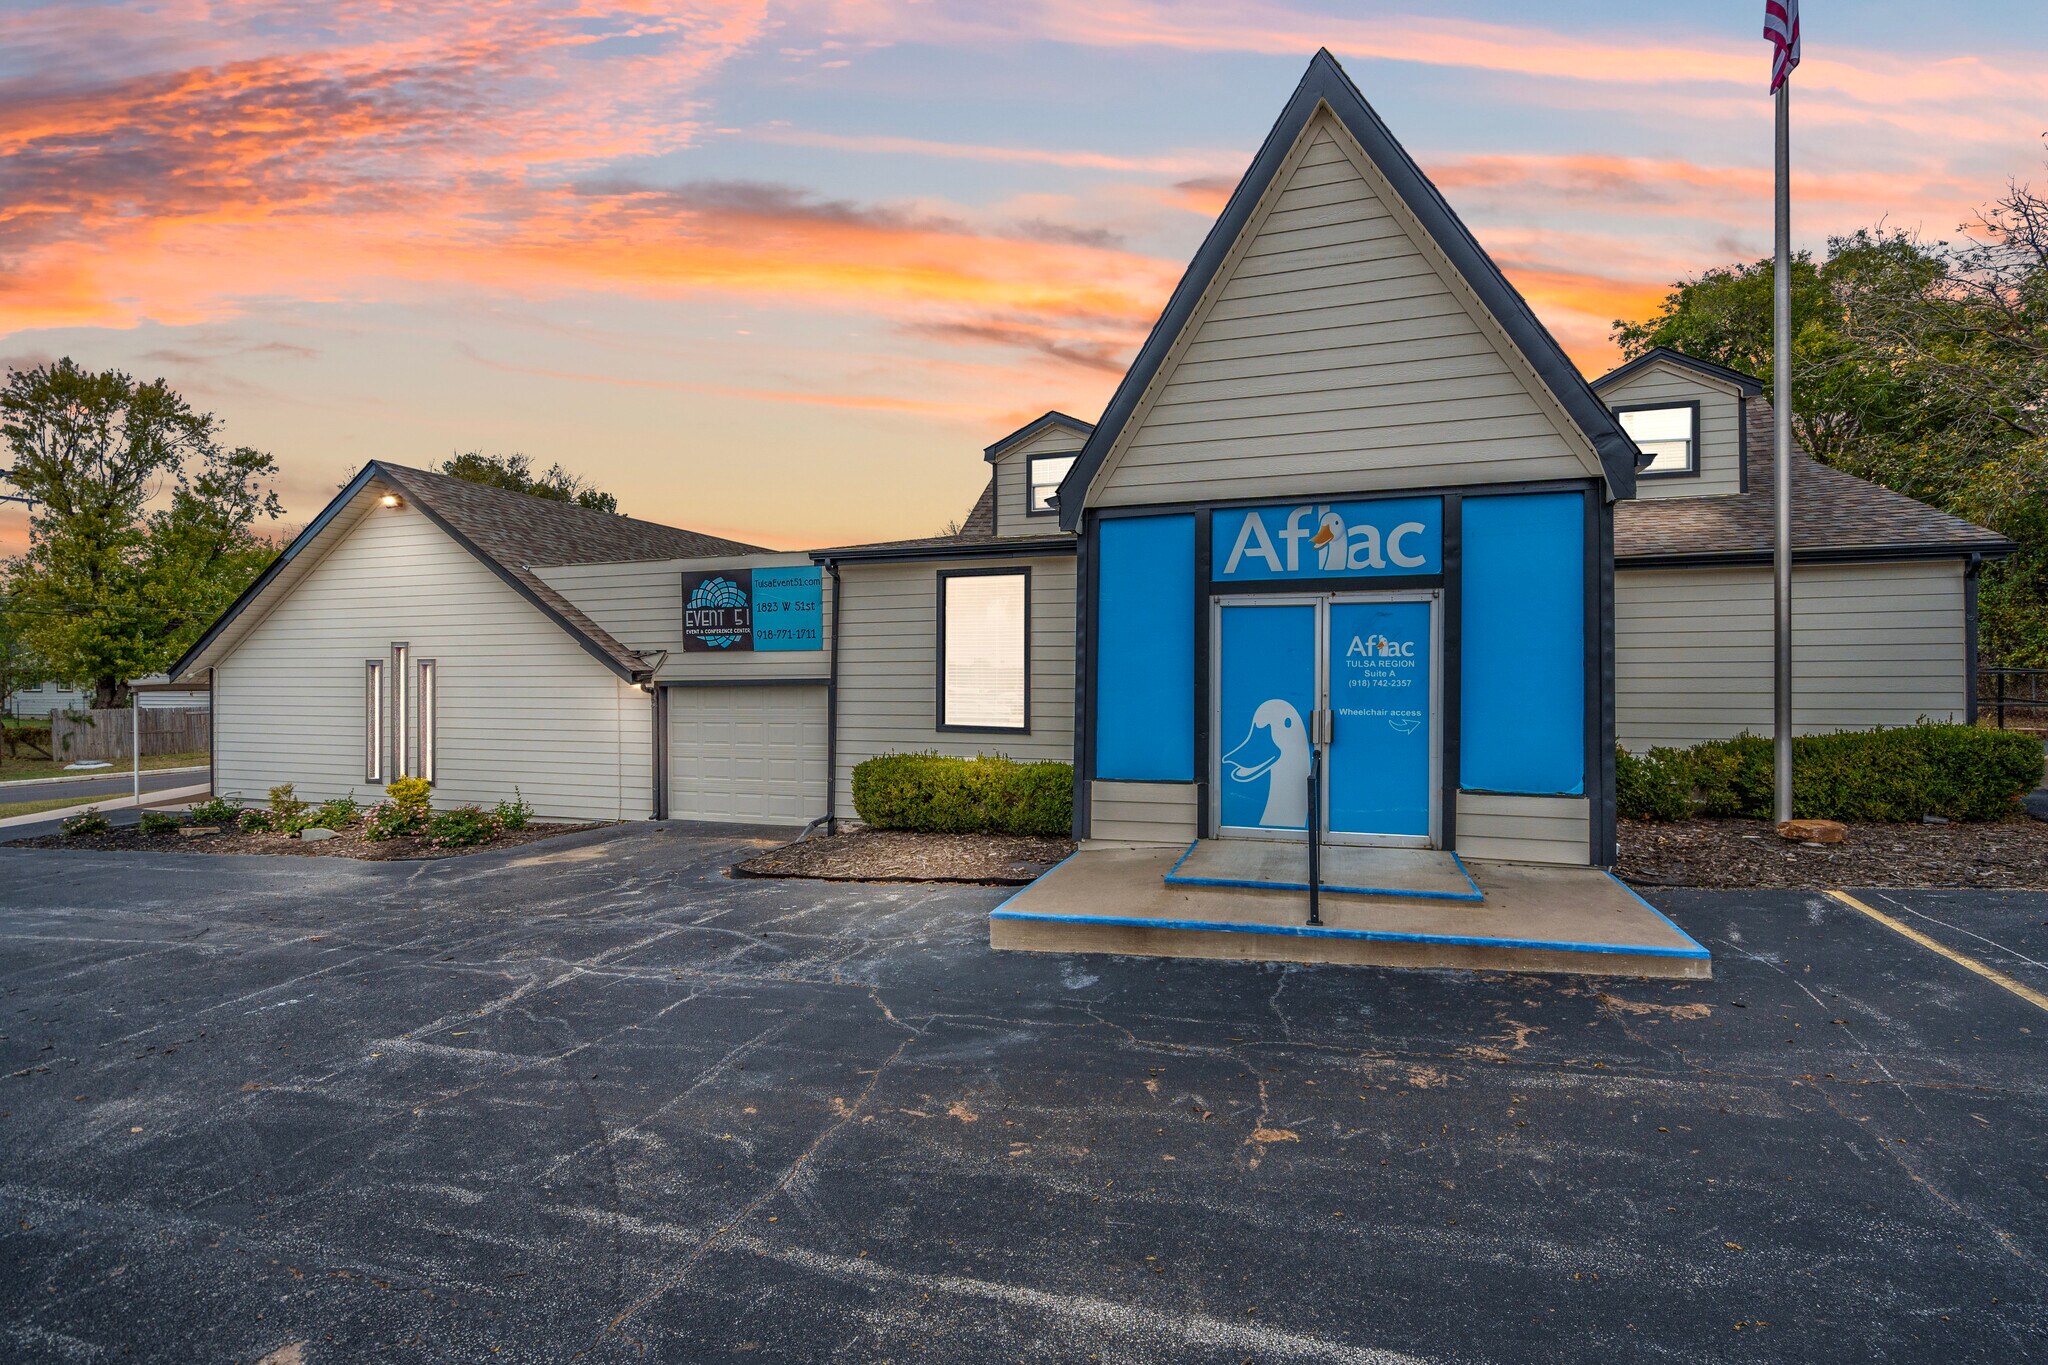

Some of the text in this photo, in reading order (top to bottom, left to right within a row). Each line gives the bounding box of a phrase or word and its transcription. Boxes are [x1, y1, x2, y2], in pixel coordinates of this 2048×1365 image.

[754, 578, 821, 588] TulsaEvent51.com
[756, 601, 815, 612] 1823 W 51st
[685, 608, 750, 627] EVENT 51
[756, 628, 816, 640] 918-771-1711
[1346, 660, 1415, 668] TULSA REGION
[1364, 670, 1387, 678] Suite
[1348, 680, 1370, 688] (918)
[1339, 708, 1422, 717] Wheelchair access
